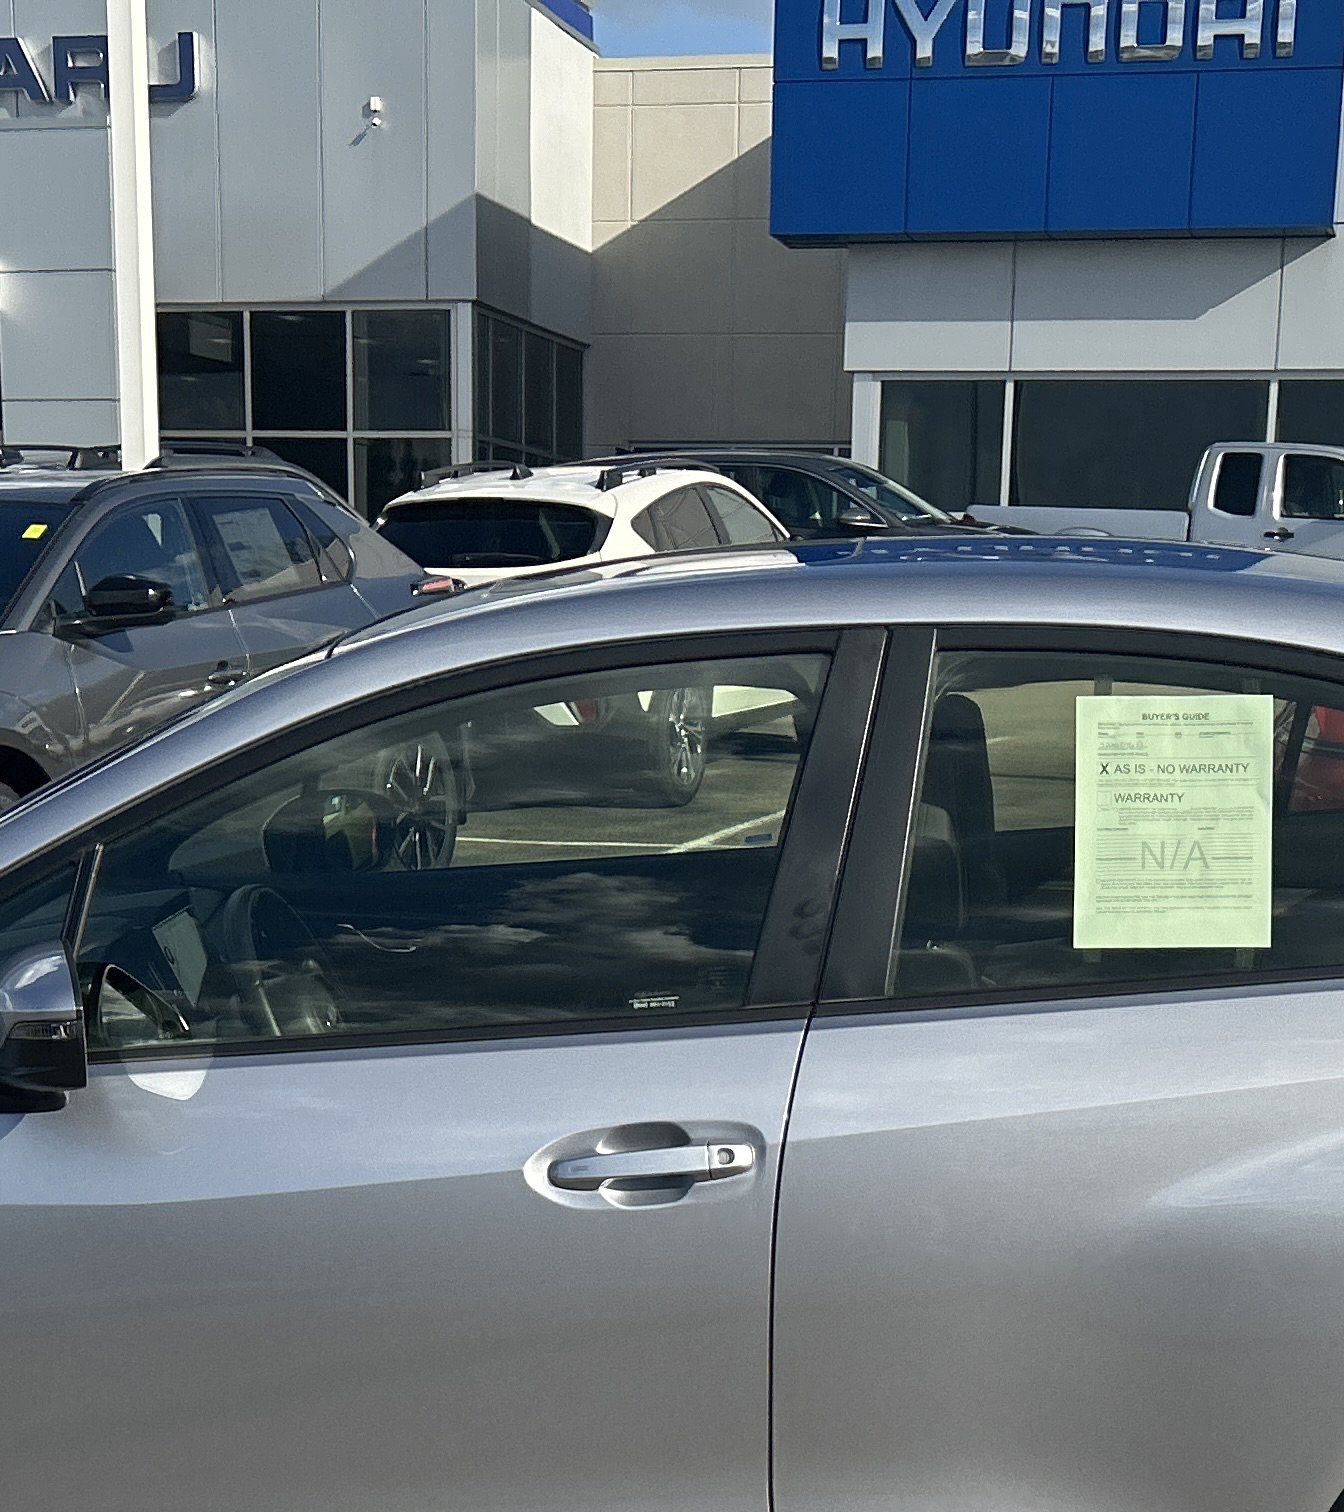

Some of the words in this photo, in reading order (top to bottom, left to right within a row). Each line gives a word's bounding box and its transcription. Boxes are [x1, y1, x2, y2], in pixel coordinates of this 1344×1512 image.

[820, 0, 1295, 70] HYUNDAI
[1141, 712, 1180, 721] BUYER'S
[1182, 712, 1210, 721] GUIDE
[1099, 763, 1110, 775] X
[1114, 764, 1131, 774] AS
[1134, 764, 1146, 774] IS
[1157, 764, 1176, 774] NO
[1179, 763, 1250, 774] WARRANTY
[1114, 793, 1185, 804] WARRANTY
[1141, 839, 1210, 870] N/A
